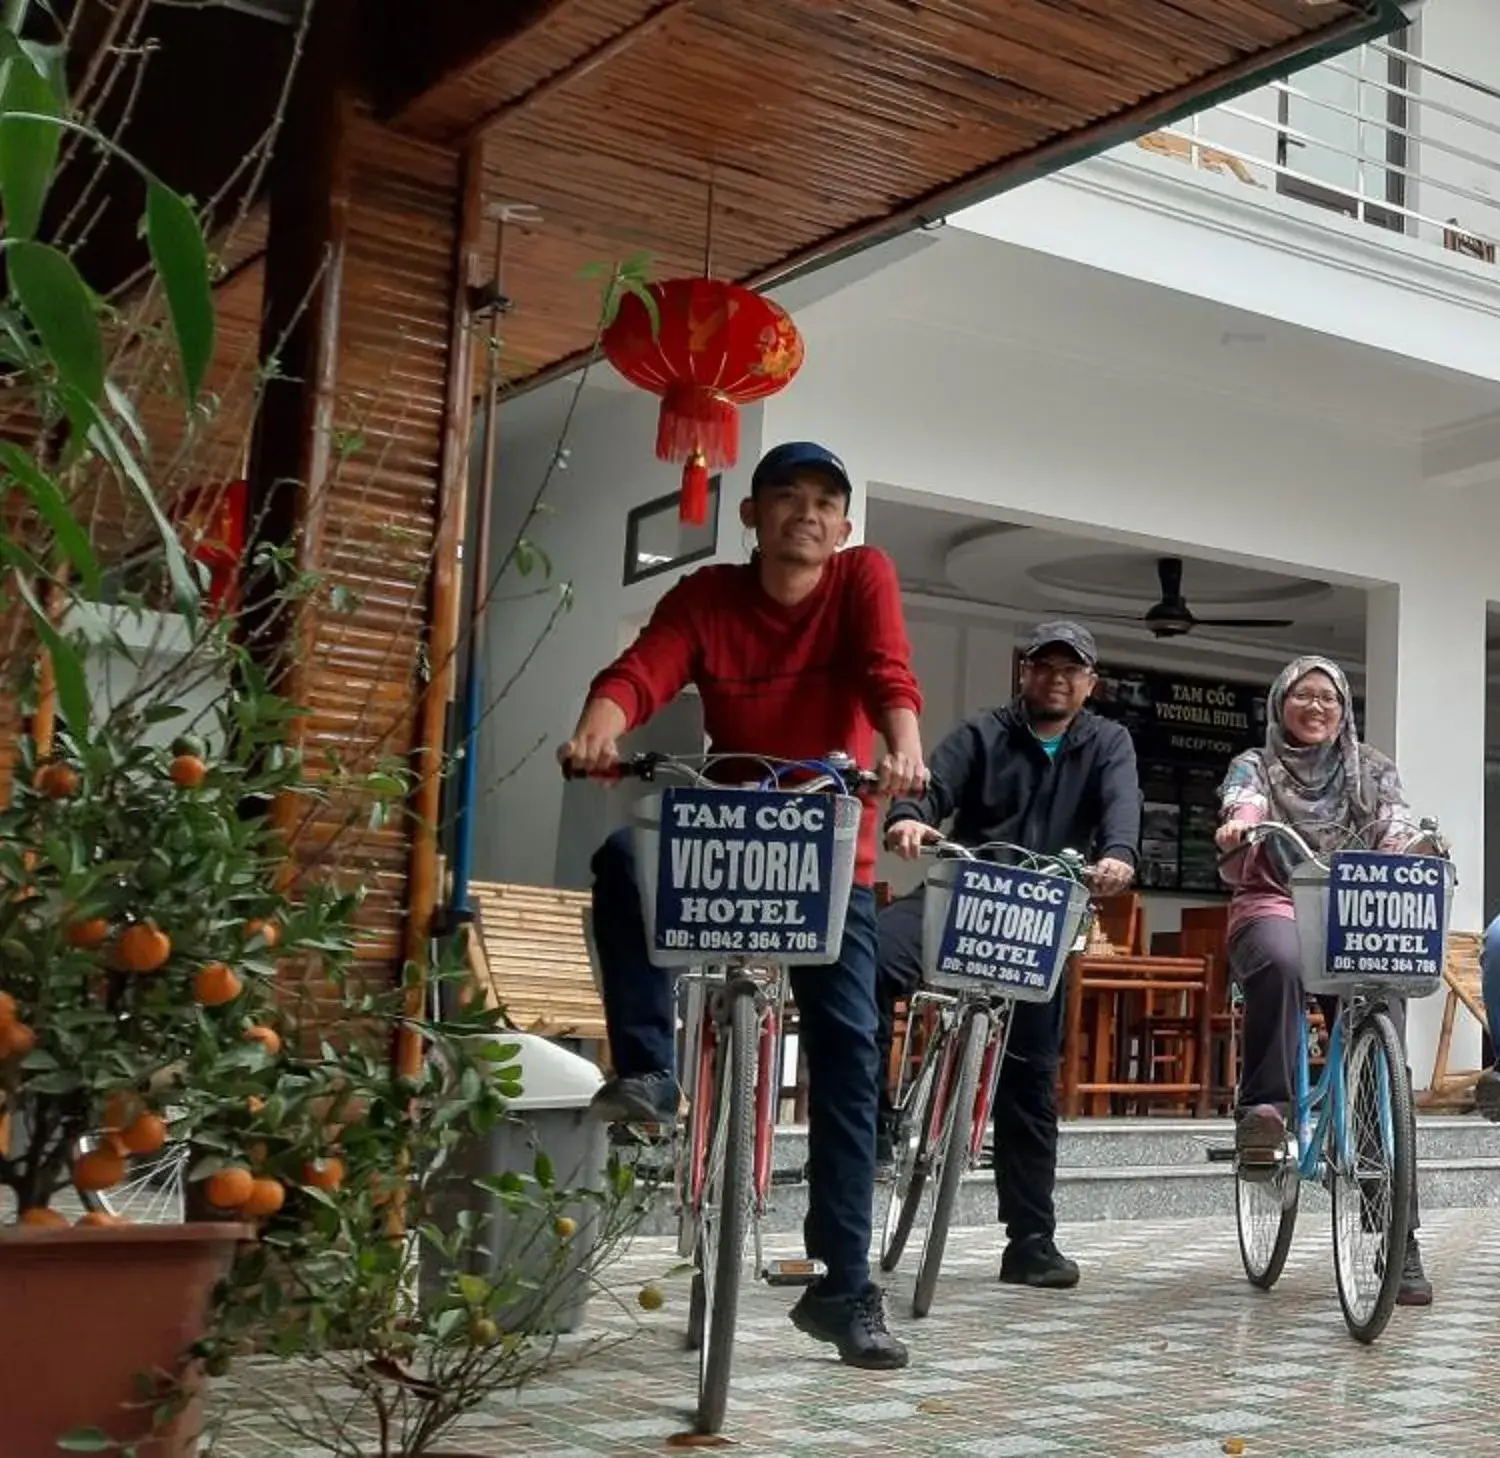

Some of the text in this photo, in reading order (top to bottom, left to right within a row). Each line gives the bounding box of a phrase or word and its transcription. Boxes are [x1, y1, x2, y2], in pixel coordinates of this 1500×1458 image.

[1171, 684, 1203, 702] TAM
[1155, 702, 1248, 728] VICTORIA HOTEL
[1171, 736, 1231, 753] RECEPTION
[673, 798, 824, 831] TAM CỐC
[671, 838, 820, 892] VICTORIA
[1338, 860, 1439, 885] TAM CỐC
[964, 872, 1064, 904] TAM CỐC
[680, 898, 806, 924] HOTEL
[955, 895, 1055, 946] VICTORIA
[1338, 889, 1437, 930] VICTORIA
[700, 931, 742, 948] 0942
[750, 932, 780, 949] 364
[787, 932, 817, 949] 706
[956, 936, 1040, 967] HOTEL
[1345, 932, 1428, 953] HOTEL
[1358, 957, 1388, 971] 0942
